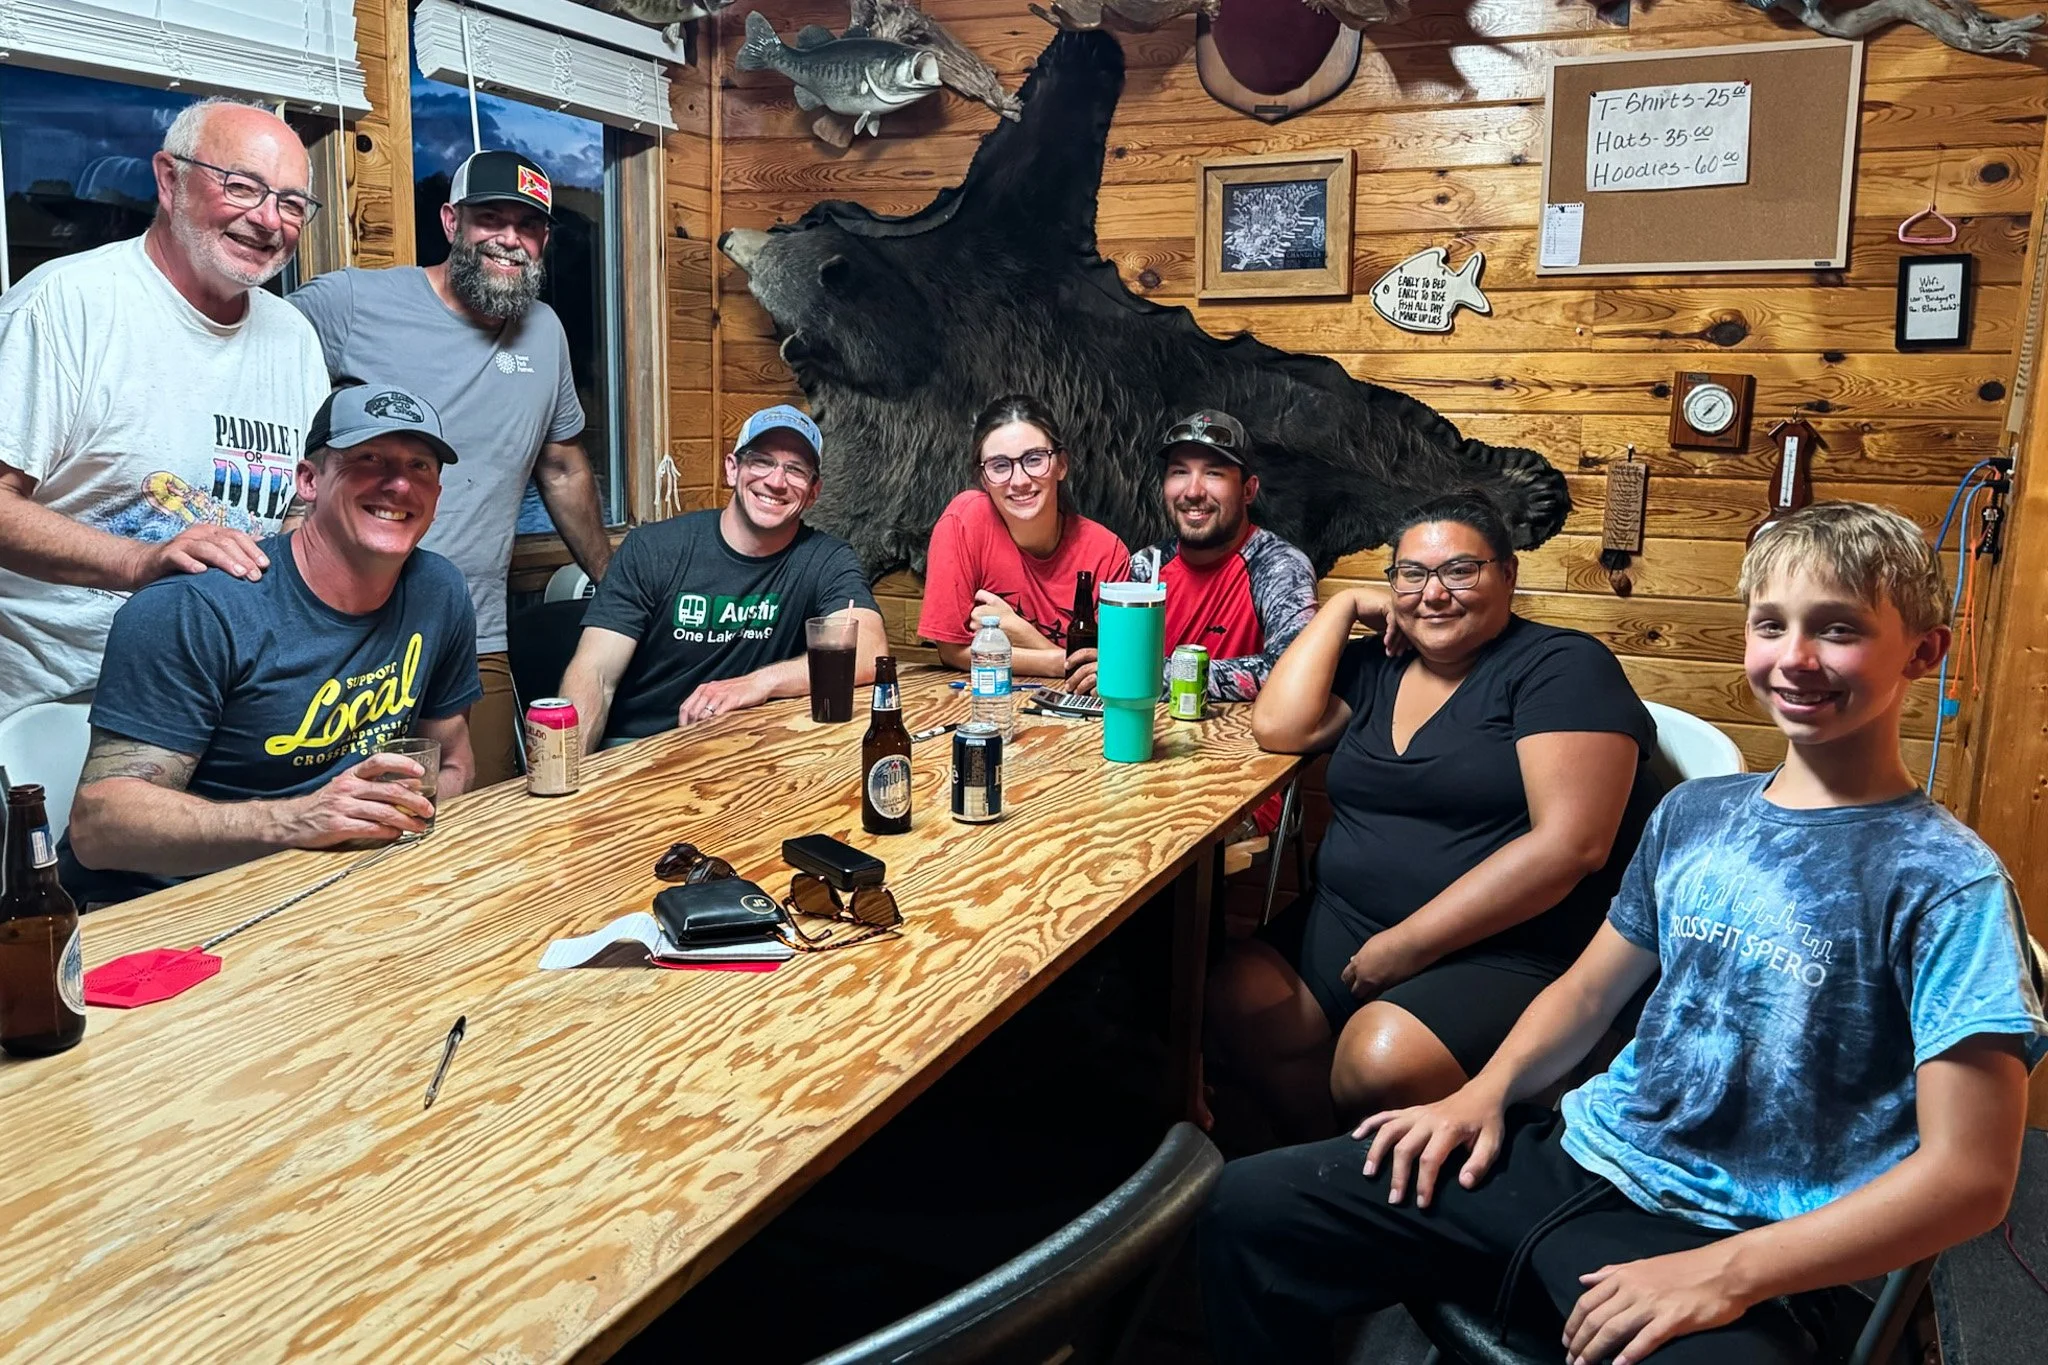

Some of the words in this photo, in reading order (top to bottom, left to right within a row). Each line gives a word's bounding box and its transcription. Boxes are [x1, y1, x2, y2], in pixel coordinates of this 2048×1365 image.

[1397, 275, 1420, 288] EARLY
[1421, 276, 1431, 289] TO
[1432, 278, 1446, 290] BED
[1397, 287, 1419, 300] EARLY
[1421, 289, 1429, 301] TO
[1398, 299, 1414, 311] FISH
[1414, 301, 1428, 312] ALL
[1430, 303, 1444, 315] DAY
[1398, 310, 1418, 322] MAKE
[1418, 313, 1428, 323] UP
[1428, 314, 1441, 326] LIES
[213, 414, 292, 456] PADDLE
[244, 450, 263, 464] OR
[211, 458, 293, 520] DIE
[672, 628, 704, 642] One
[264, 632, 423, 756] Local
[1740, 933, 1827, 987] SPERO
